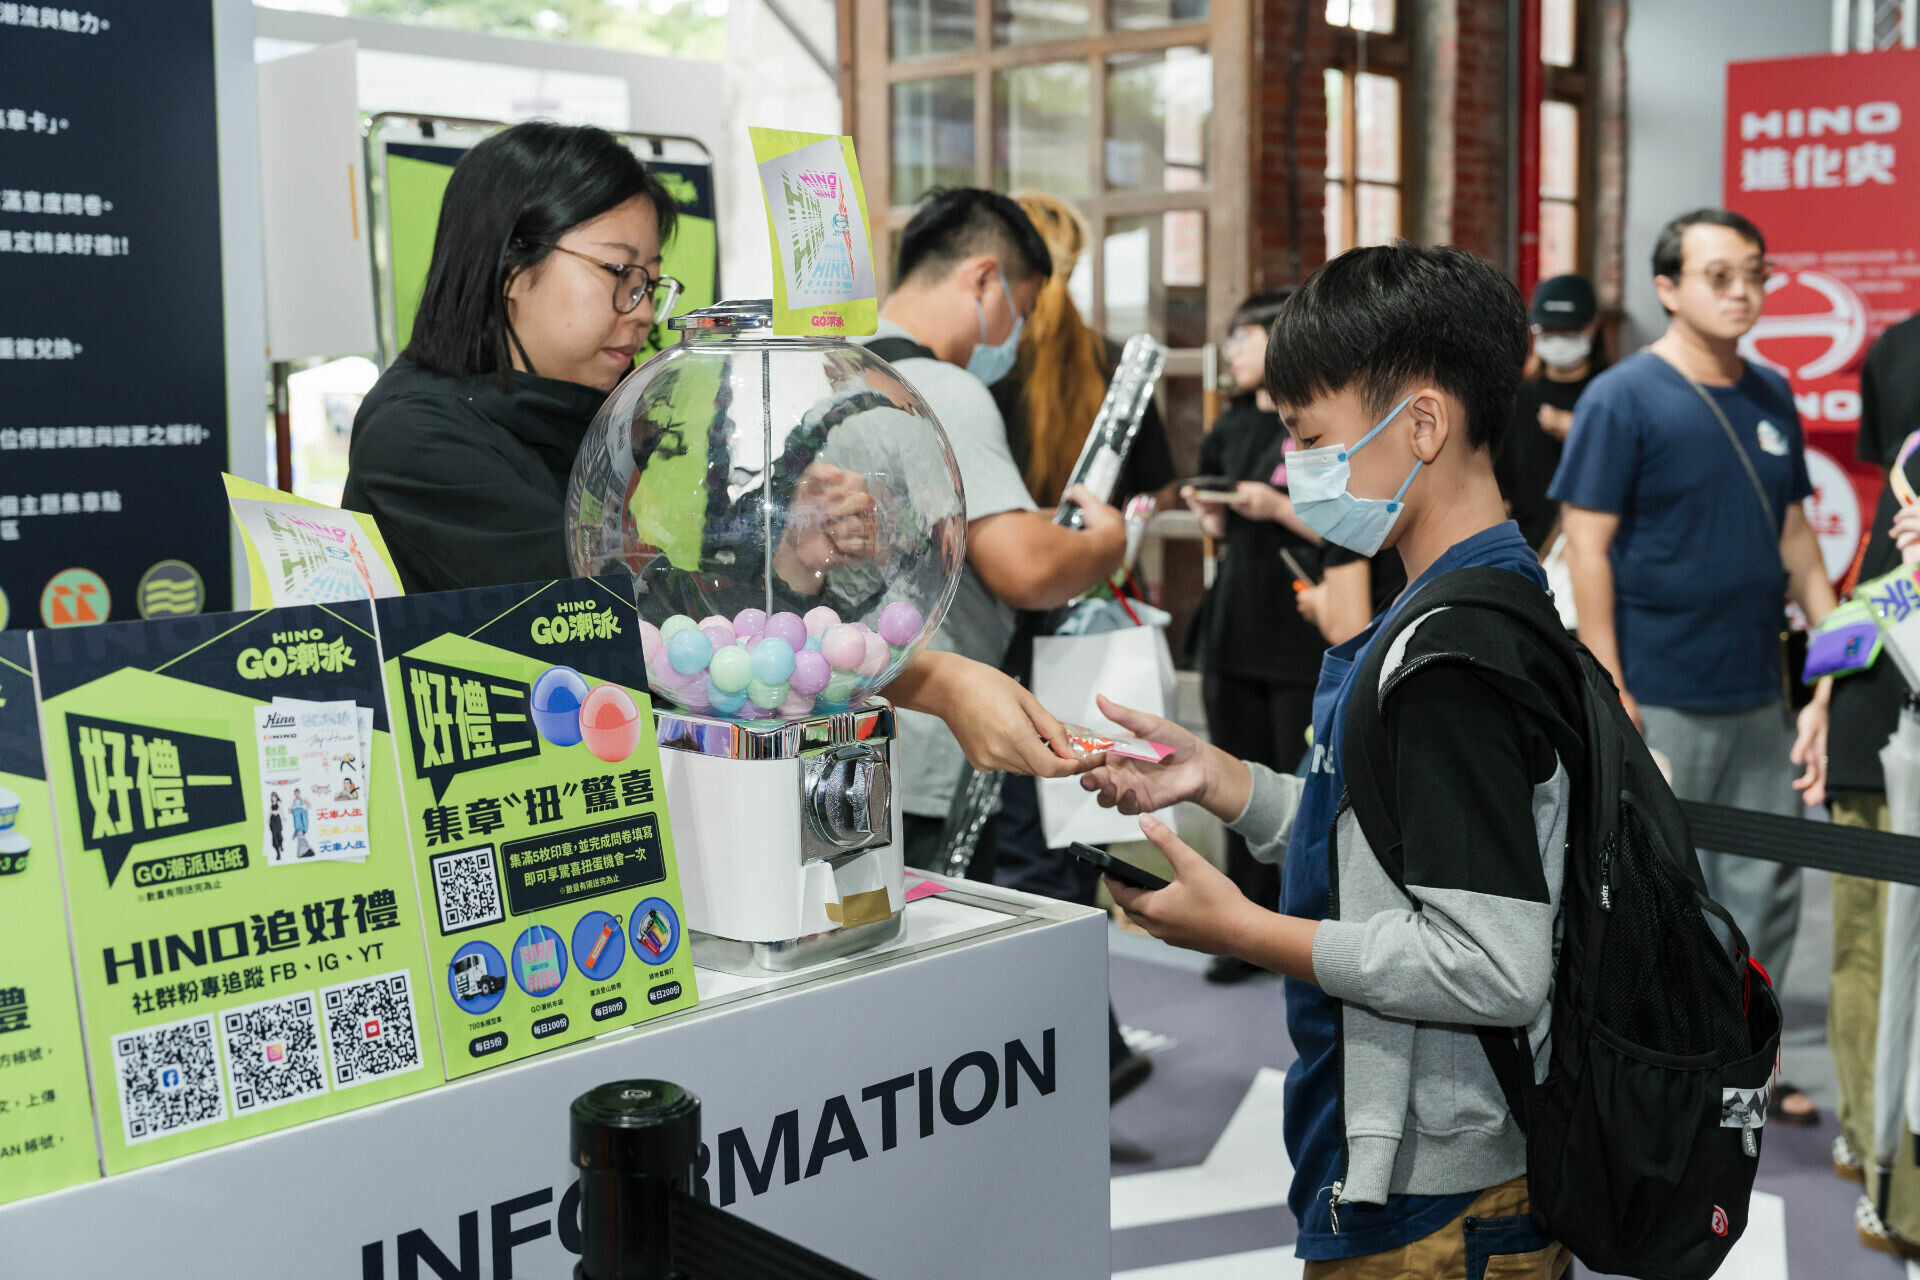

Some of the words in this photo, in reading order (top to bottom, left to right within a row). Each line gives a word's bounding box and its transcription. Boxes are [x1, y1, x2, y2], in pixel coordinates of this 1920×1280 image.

[0, 108, 70, 135] 章卡」。
[1741, 102, 1901, 140] HINO
[556, 599, 597, 614] HINO
[272, 628, 324, 644] HINO
[530, 606, 622, 645] GO潮派
[236, 635, 356, 680] GO潮派
[262, 711, 297, 729] Hino
[410, 667, 533, 769] 好禮三
[78, 725, 233, 840] 好禮一
[135, 847, 245, 884] GO潮派貼紙
[523, 847, 647, 887] 即可享驚喜扭蛋機會一次
[103, 889, 401, 985] HINO追好禮
[132, 965, 265, 1015] 社群粉專追蹤
[649, 984, 680, 1001] 每日200份
[533, 1018, 568, 1035] 每日100份
[594, 1001, 623, 1017] 每日80份
[475, 1036, 503, 1052] 每日5份
